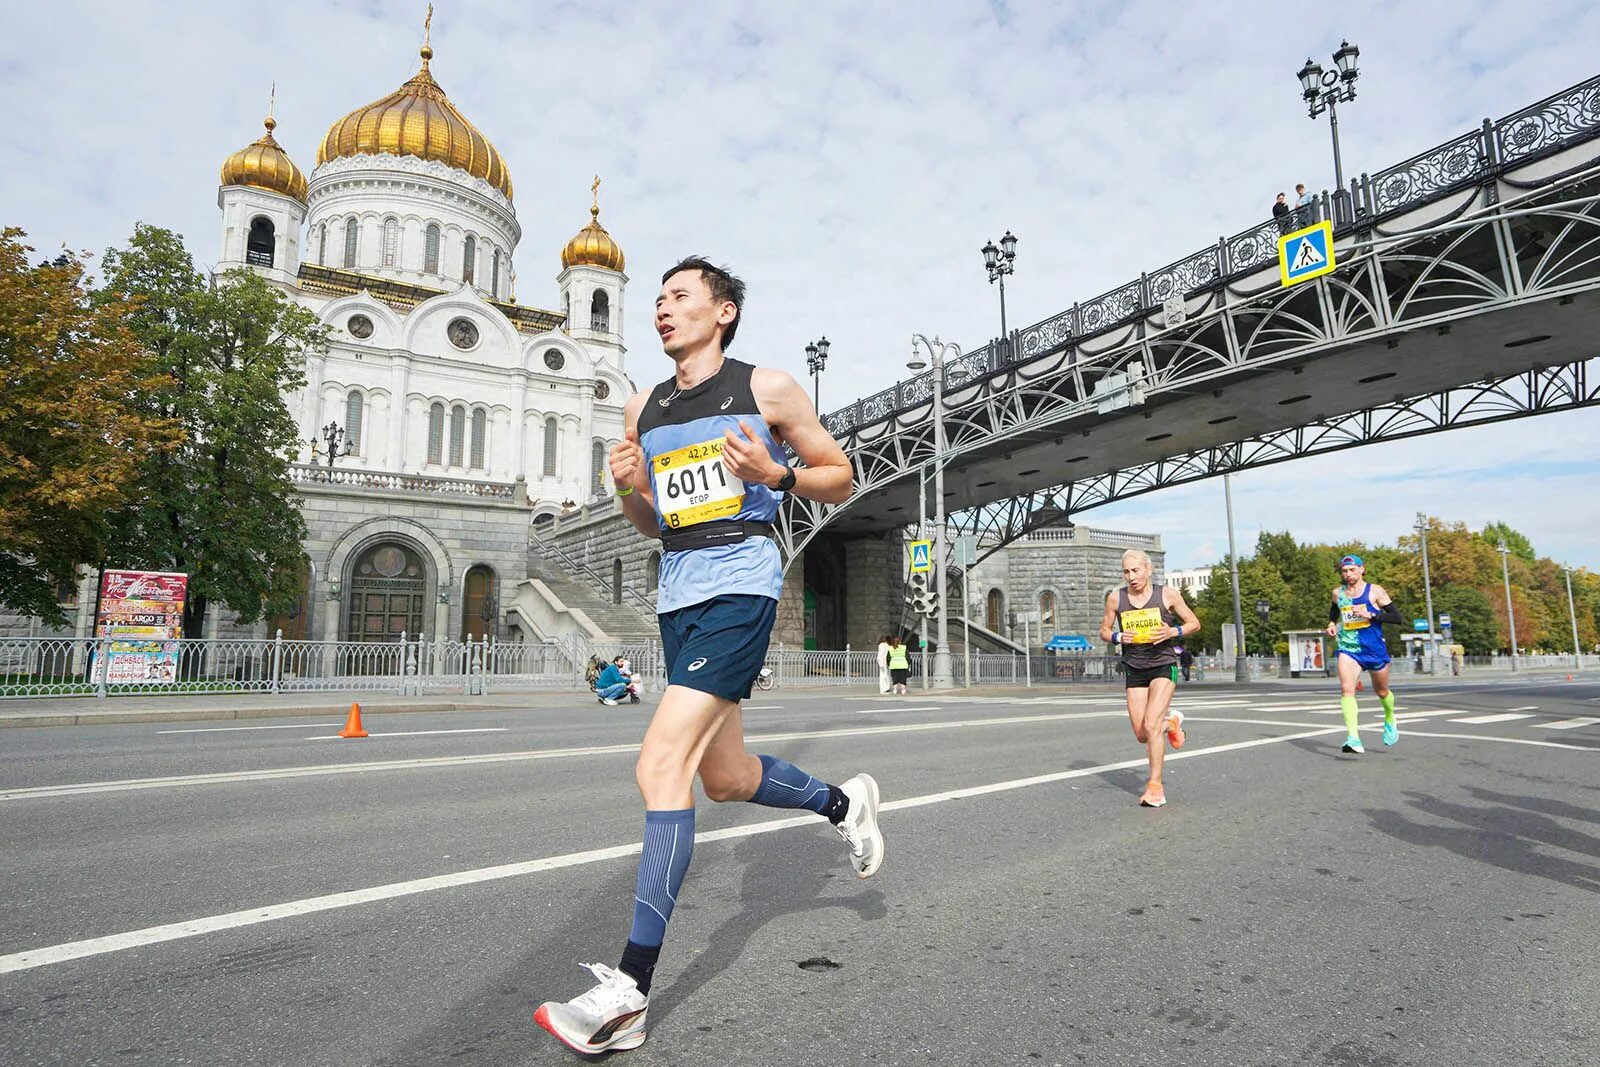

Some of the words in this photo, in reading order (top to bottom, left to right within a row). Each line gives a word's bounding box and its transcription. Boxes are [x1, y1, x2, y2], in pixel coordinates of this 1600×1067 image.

[688, 446, 709, 460] 42,2
[711, 443, 723, 455] К
[667, 461, 726, 499] 6011
[689, 493, 709, 505] ЕГОР
[129, 615, 155, 625] LARGO
